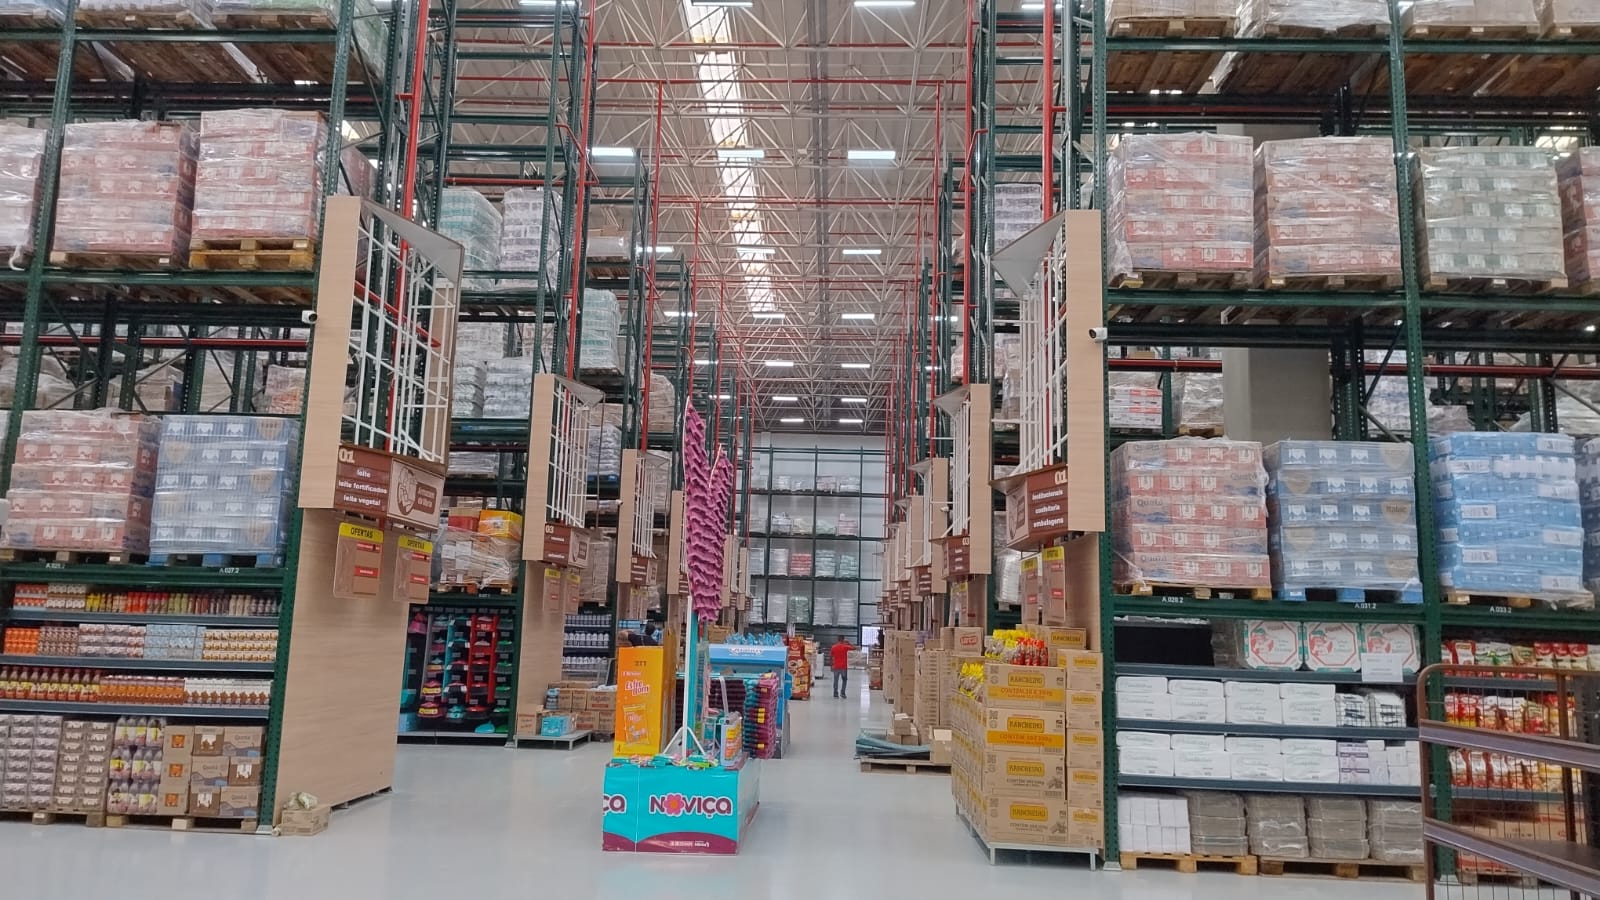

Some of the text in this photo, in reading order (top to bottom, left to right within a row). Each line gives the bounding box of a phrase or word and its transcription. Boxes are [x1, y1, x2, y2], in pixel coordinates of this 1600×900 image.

[338, 448, 355, 464] 01
[356, 469, 371, 478] leite
[1054, 470, 1067, 485] 01
[338, 481, 351, 489] leite
[343, 494, 381, 506] leite vegetal
[350, 527, 374, 538] OFERTAS
